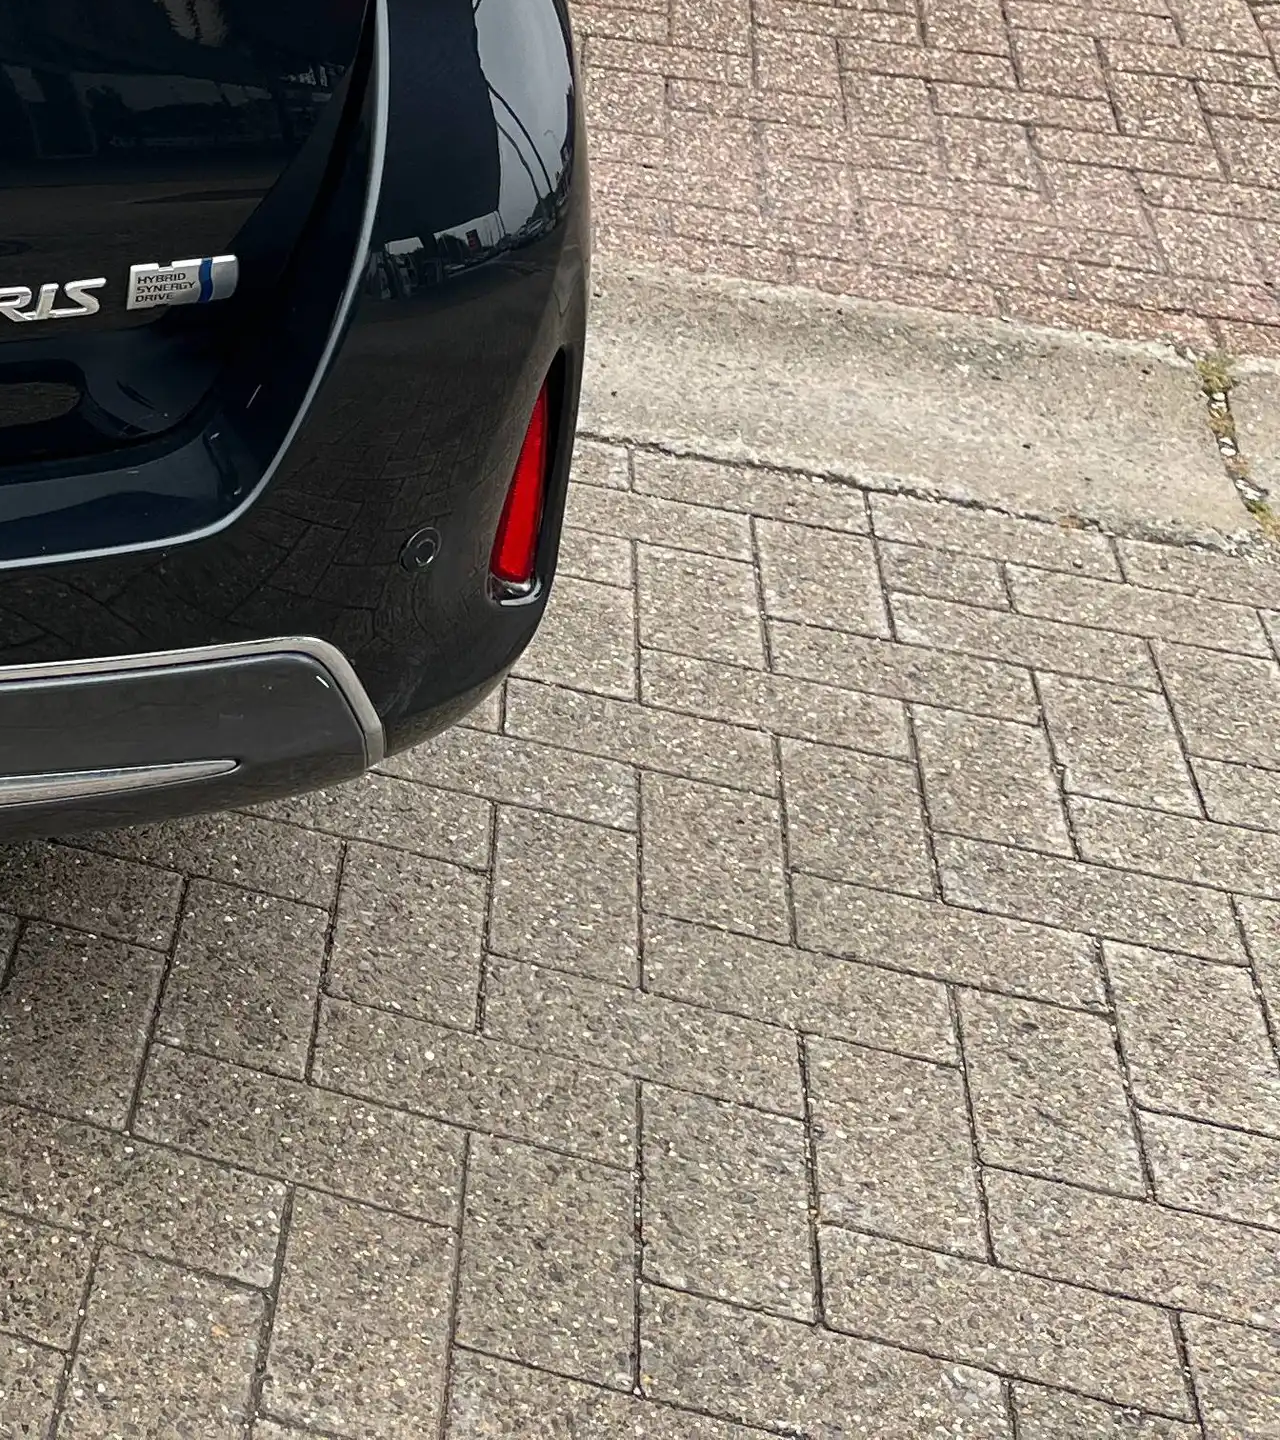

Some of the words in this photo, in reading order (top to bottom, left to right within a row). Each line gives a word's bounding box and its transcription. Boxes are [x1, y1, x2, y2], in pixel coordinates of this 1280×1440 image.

[137, 272, 187, 285] HYBRID
[136, 281, 196, 294] SYNERGY
[135, 292, 175, 303] DRIVE
